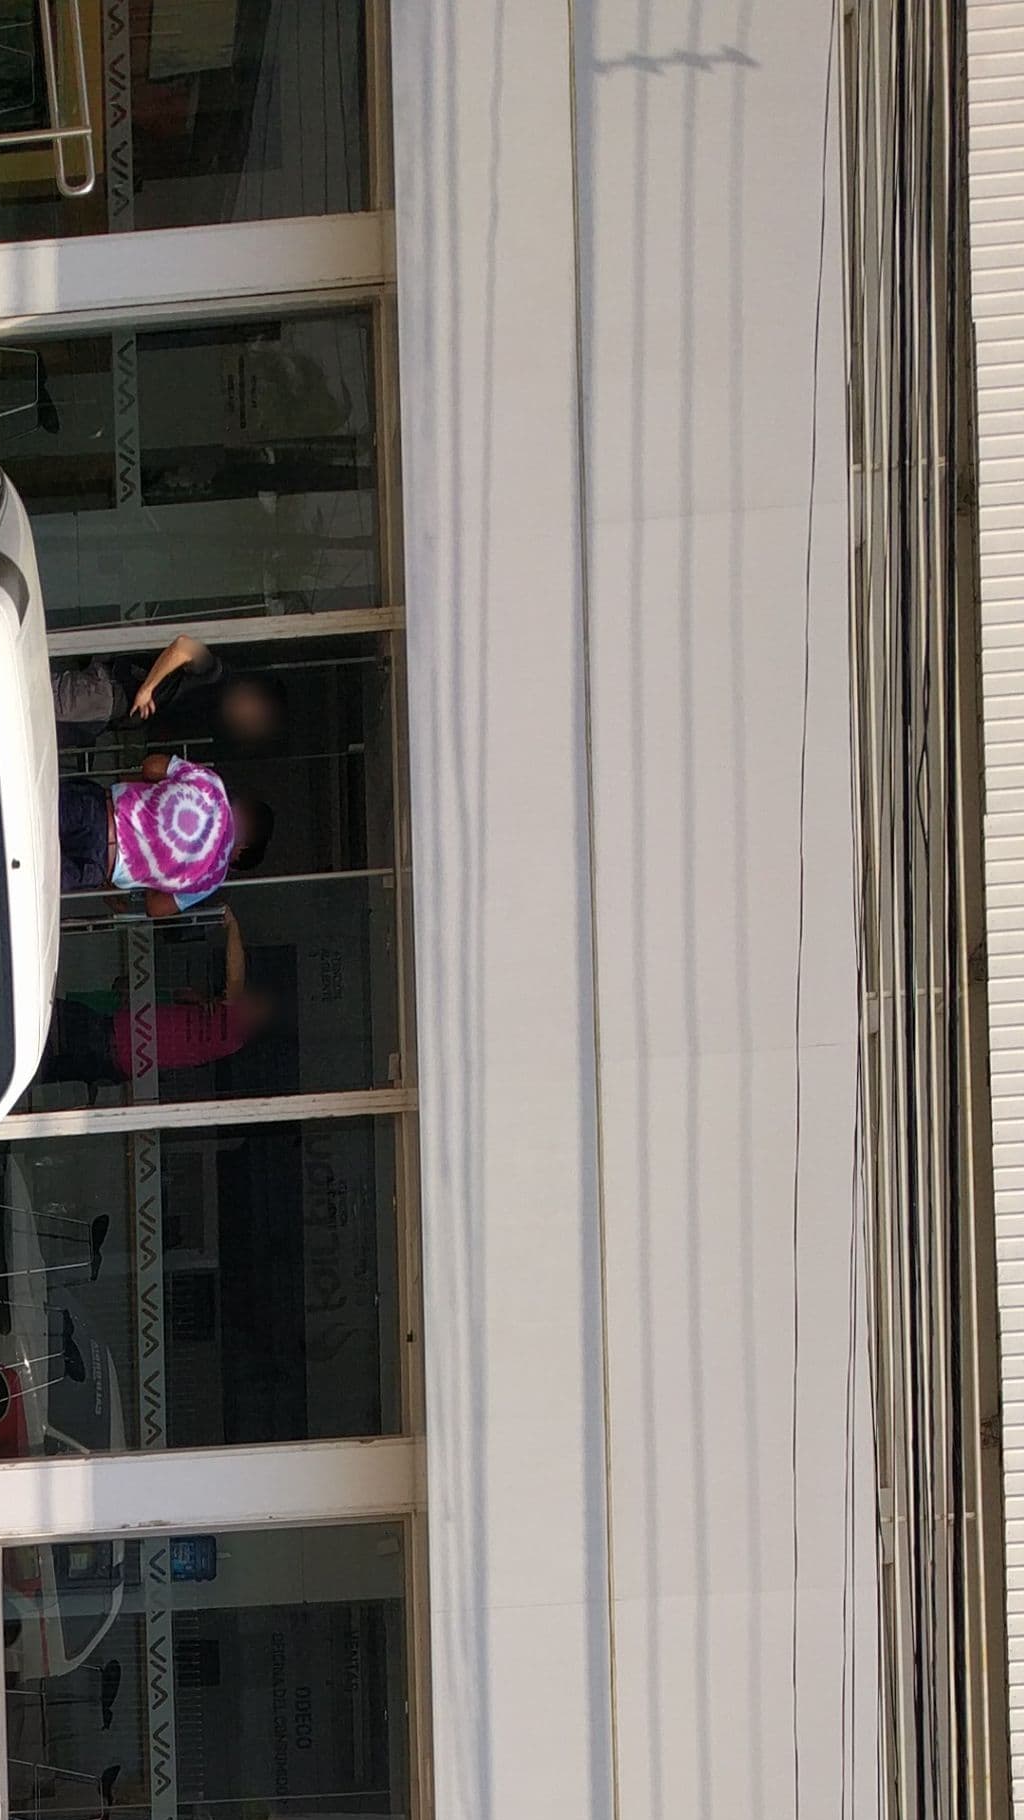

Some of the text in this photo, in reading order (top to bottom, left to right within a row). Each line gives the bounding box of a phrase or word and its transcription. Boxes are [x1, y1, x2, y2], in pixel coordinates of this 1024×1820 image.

[109, 53, 127, 128] VIVA
[112, 140, 129, 216] VIVA
[117, 339, 137, 503] VIVA VIVA
[134, 1002, 153, 1078] VIVA
[138, 1195, 158, 1271] VIVA
[141, 1283, 160, 1358] VIVA
[143, 1370, 163, 1446] VIVA
[150, 1636, 169, 1710] VIVA
[295, 1685, 313, 1750] ODECO
[152, 1721, 172, 1796] VIVA
